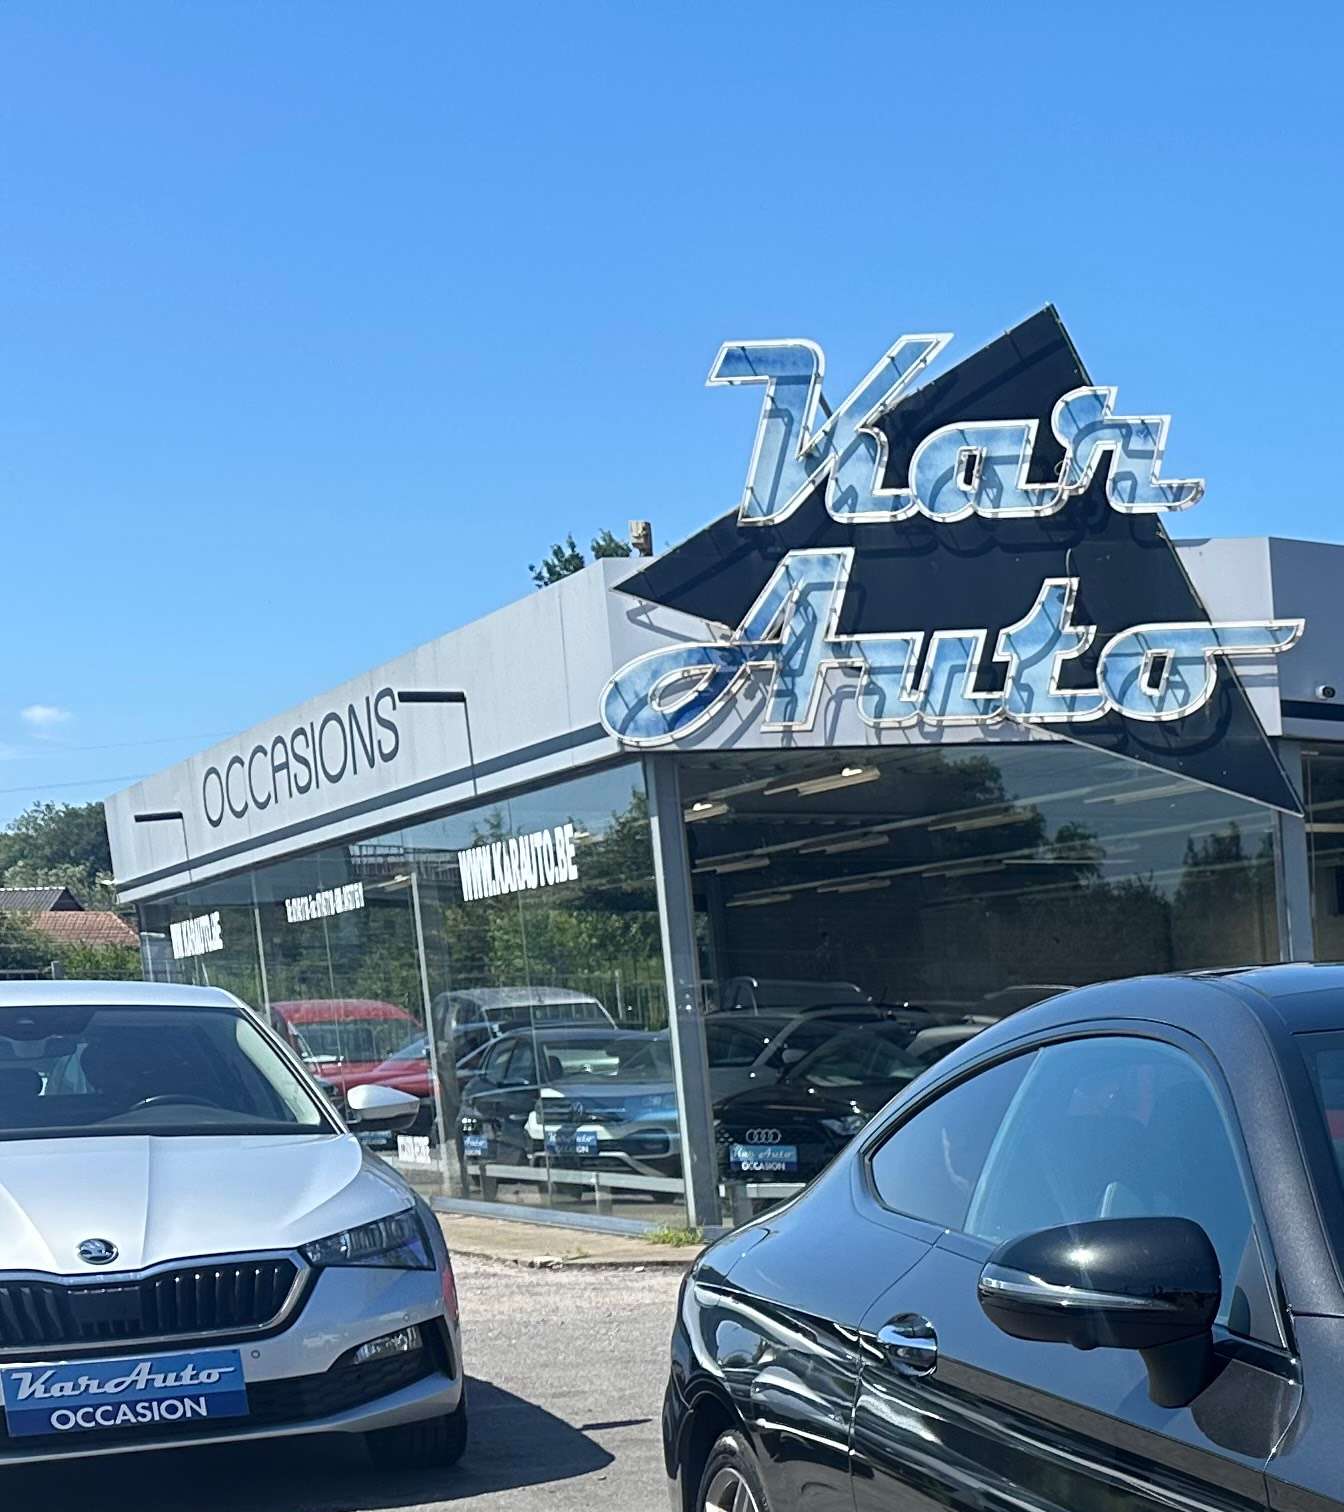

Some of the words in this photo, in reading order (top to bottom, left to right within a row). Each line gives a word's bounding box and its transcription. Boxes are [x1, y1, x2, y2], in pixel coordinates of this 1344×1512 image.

[705, 332, 1205, 527] Kar
[599, 546, 1306, 748] Auto
[202, 687, 400, 828] OCCASIONS
[50, 1397, 208, 1430] OCCASION
